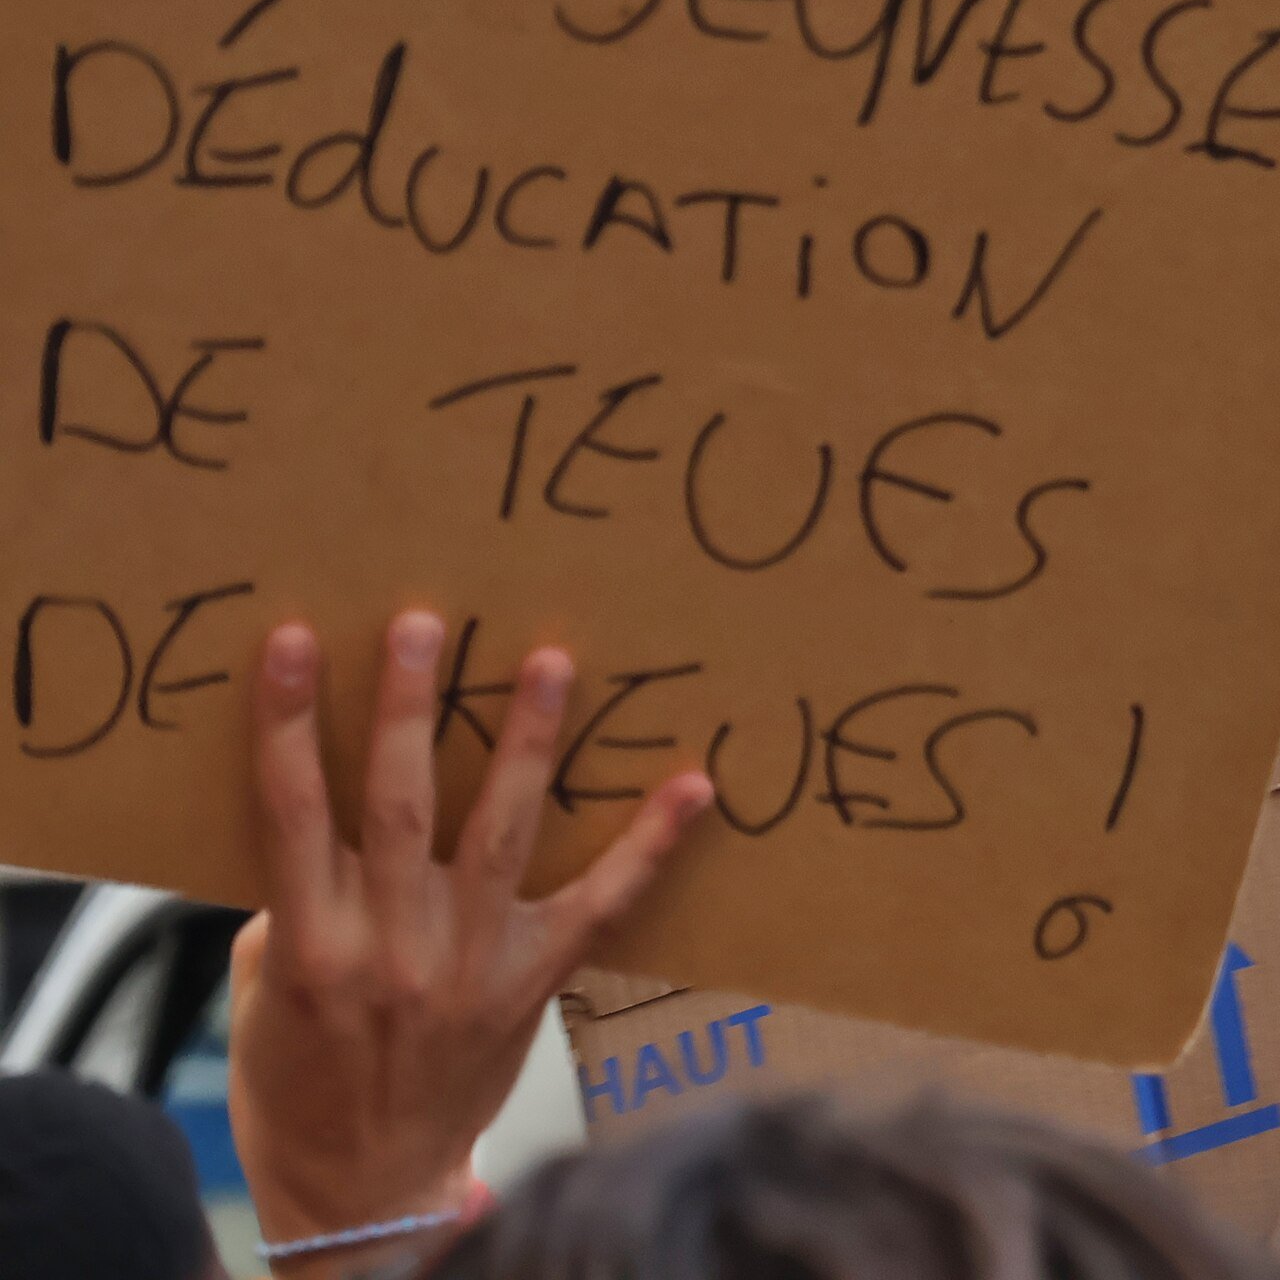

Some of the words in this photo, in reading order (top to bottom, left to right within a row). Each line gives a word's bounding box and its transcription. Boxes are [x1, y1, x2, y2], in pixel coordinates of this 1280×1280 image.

[40, 317, 266, 470] DE
[14, 581, 255, 758] DE
[577, 1004, 772, 1123] HAUT
